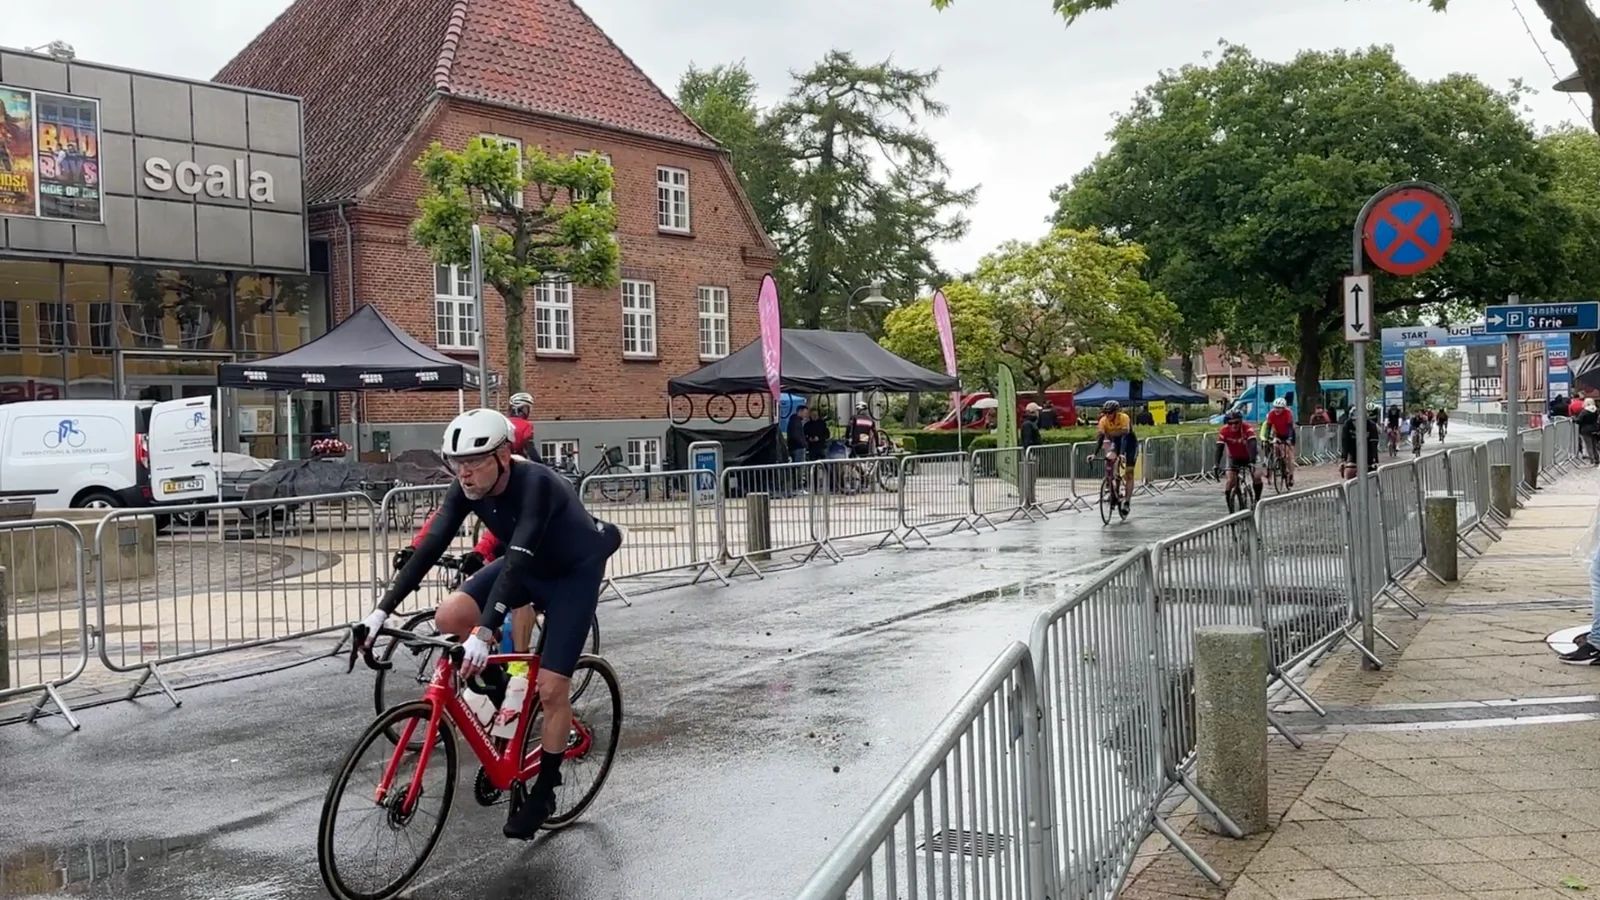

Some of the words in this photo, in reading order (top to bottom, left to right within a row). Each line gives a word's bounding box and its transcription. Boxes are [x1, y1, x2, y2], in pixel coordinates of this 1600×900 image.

[39, 123, 97, 157] BAD
[39, 155, 97, 183] BS
[143, 156, 275, 203] scala
[40, 183, 63, 195] RIDE
[65, 186, 79, 197] OR
[83, 188, 98, 199] DIE
[1528, 306, 1577, 315] Ramsherred
[1510, 314, 1519, 325] P
[1528, 316, 1535, 328] 6
[1401, 331, 1428, 340] START
